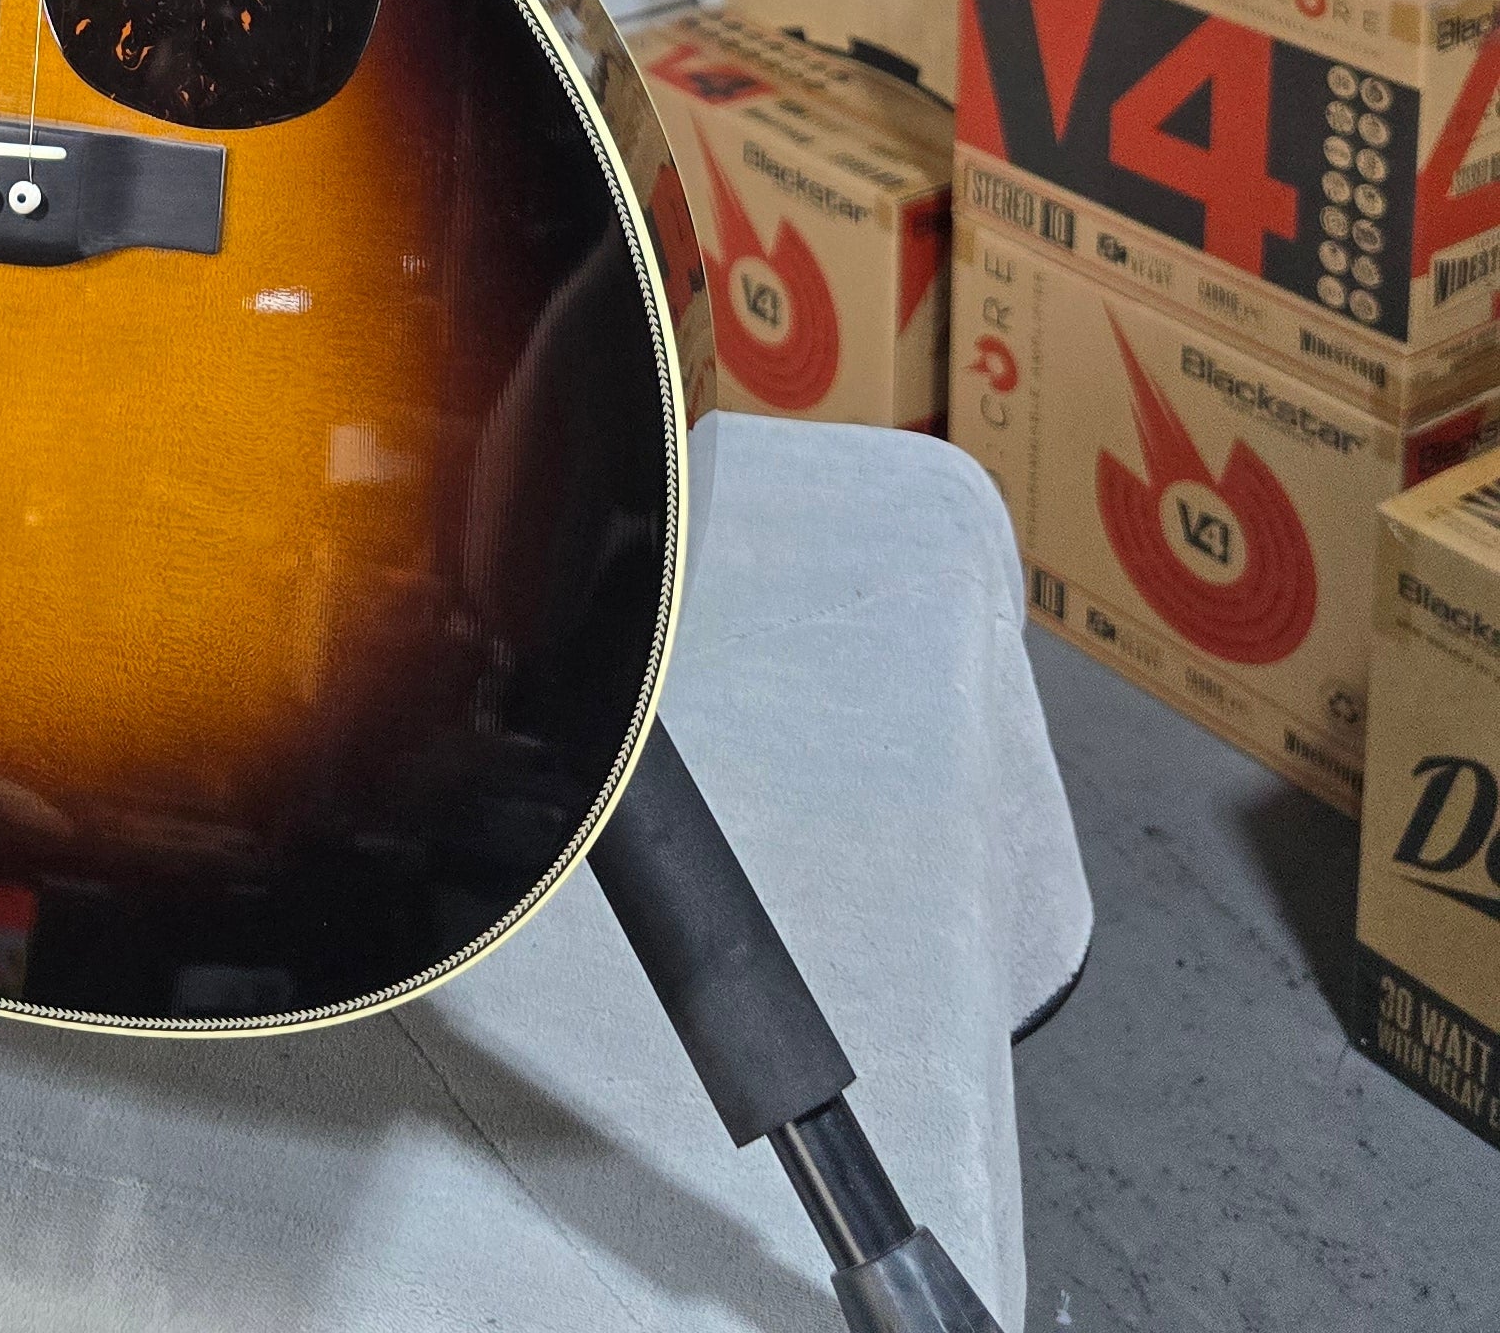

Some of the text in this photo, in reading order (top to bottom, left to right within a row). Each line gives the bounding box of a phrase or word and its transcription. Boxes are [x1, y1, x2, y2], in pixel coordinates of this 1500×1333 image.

[743, 140, 870, 223] Blackstar
[972, 171, 1035, 229] STEREO
[741, 272, 781, 331] V4
[1181, 343, 1370, 455] Blackstar
[1177, 498, 1231, 565] V4
[1380, 975, 1491, 1085] 30 WATT
